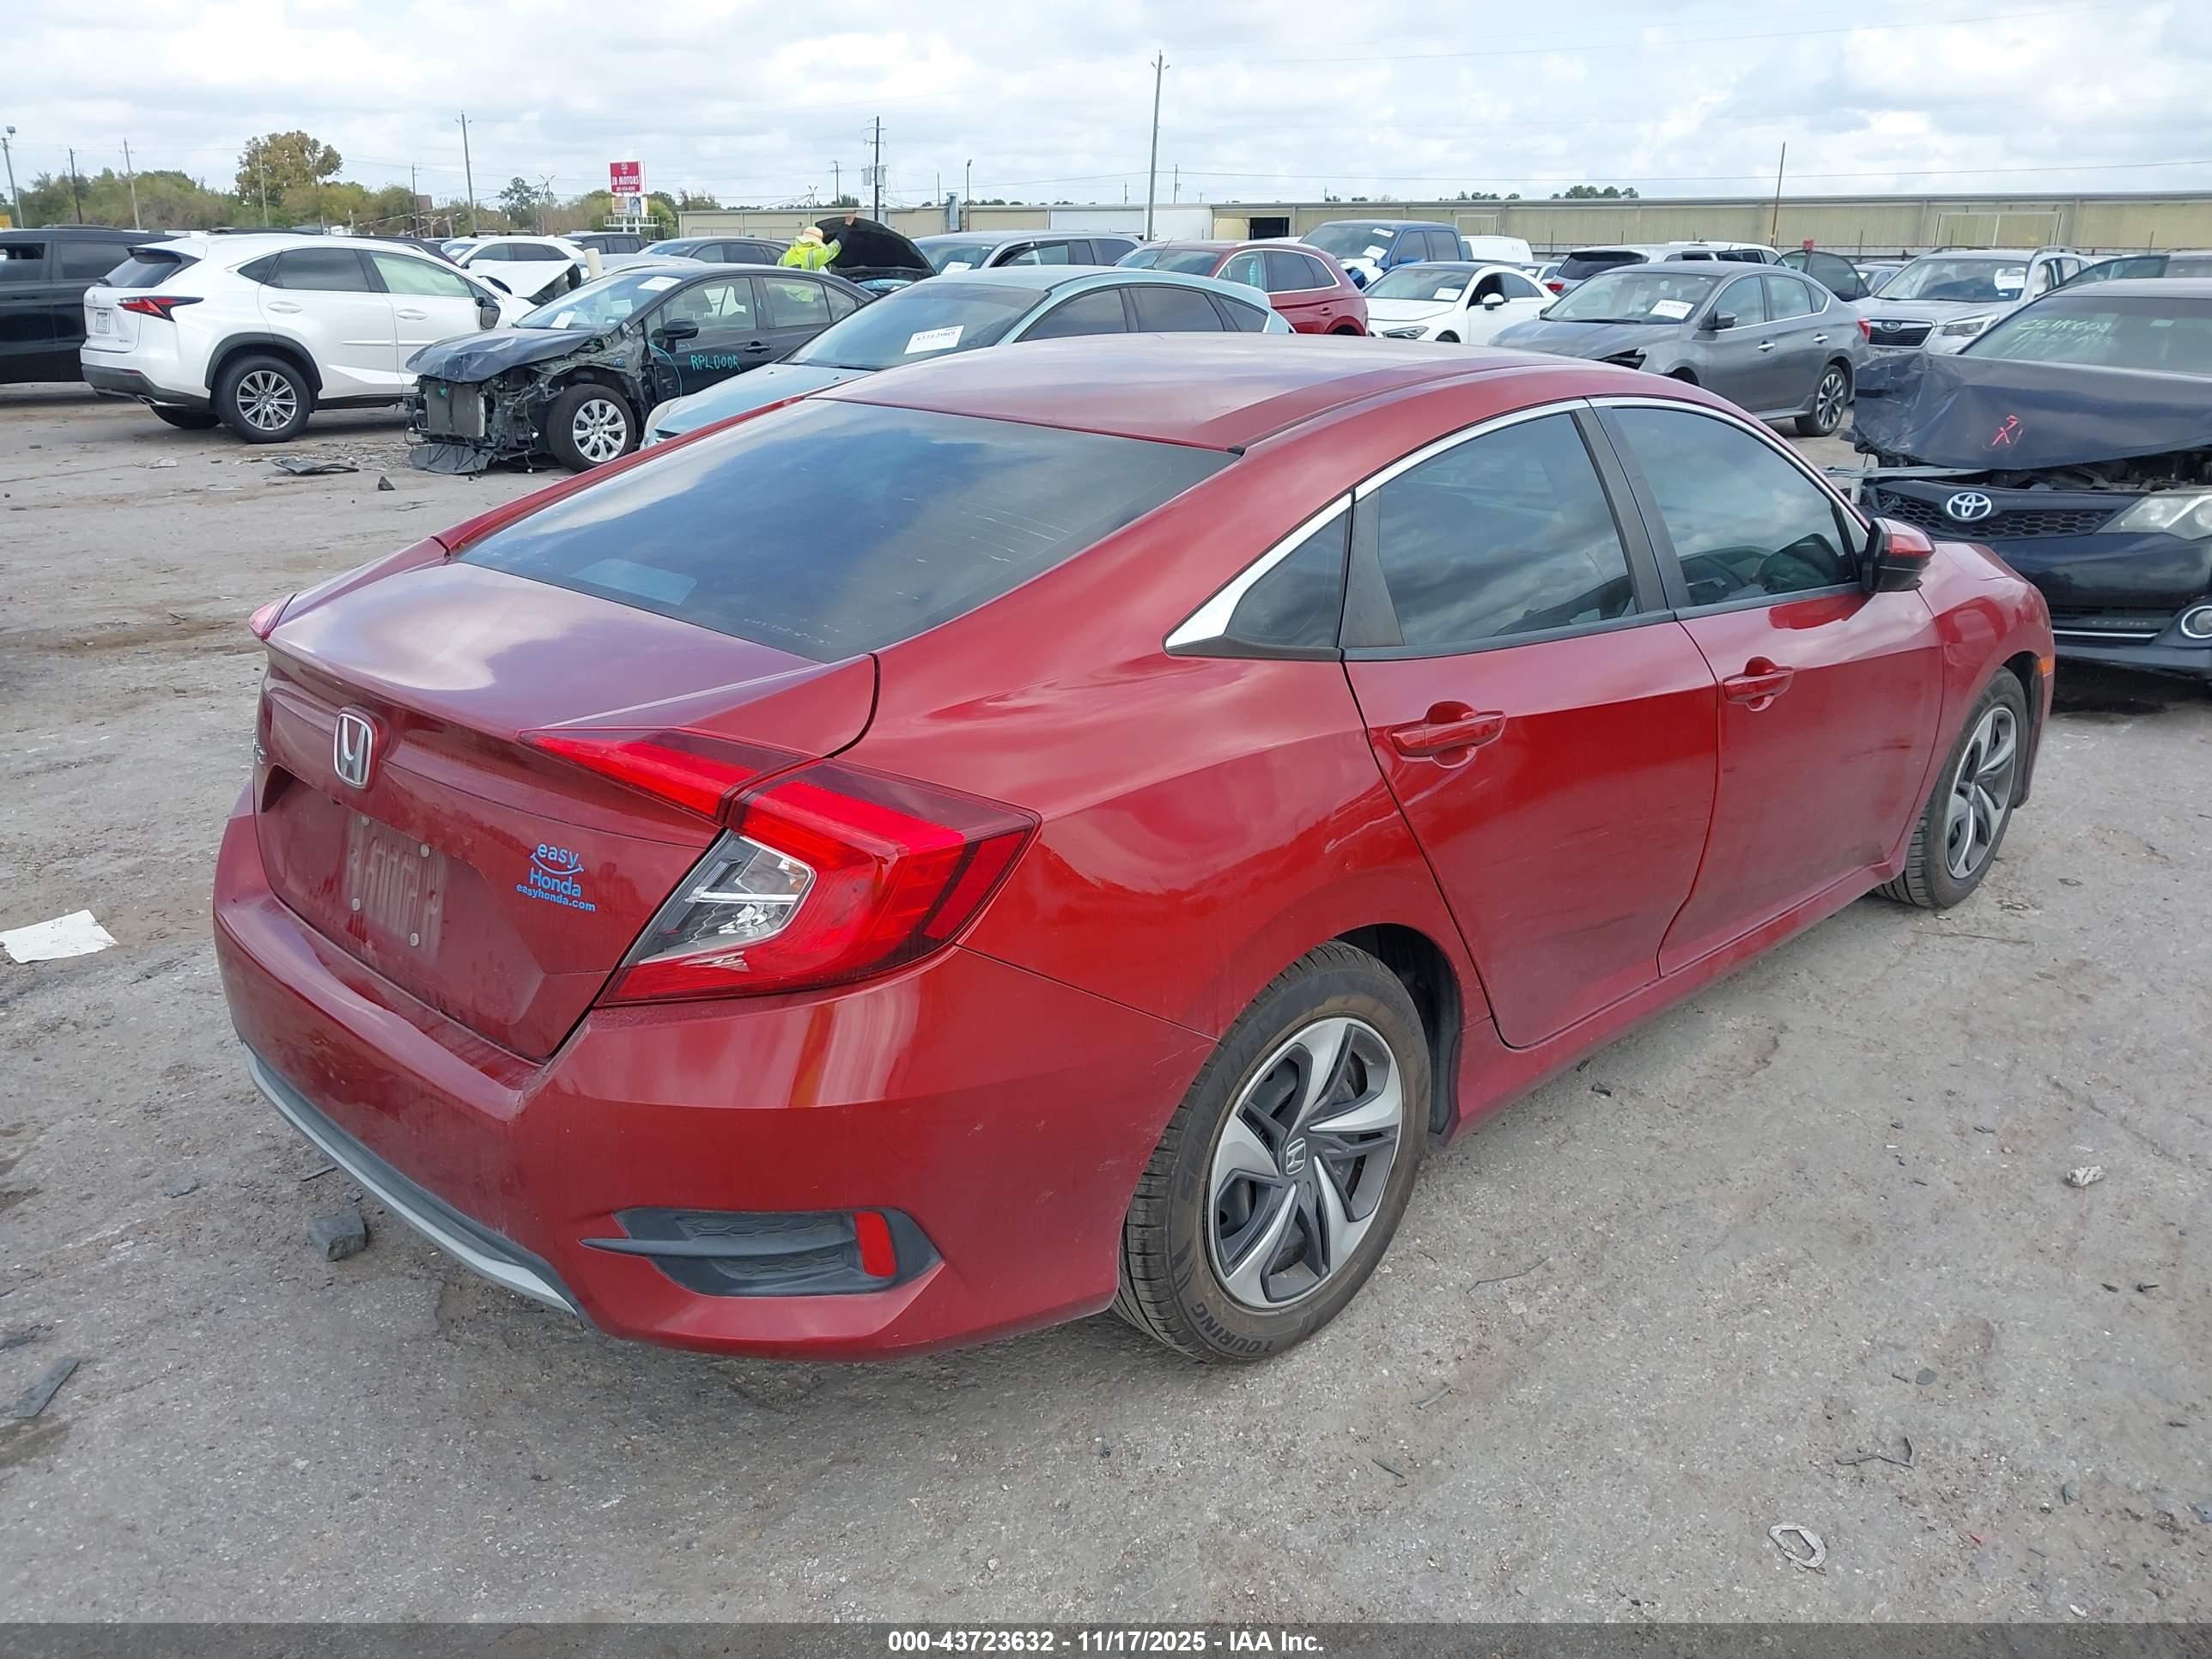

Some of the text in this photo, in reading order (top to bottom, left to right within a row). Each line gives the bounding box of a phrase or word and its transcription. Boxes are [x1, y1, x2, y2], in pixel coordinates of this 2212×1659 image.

[618, 175, 640, 185] MOTORS
[537, 843, 579, 869] easy
[529, 866, 581, 897] Honda
[516, 884, 596, 912] easyhonda.com
[1190, 1301, 1275, 1354] TOURING
